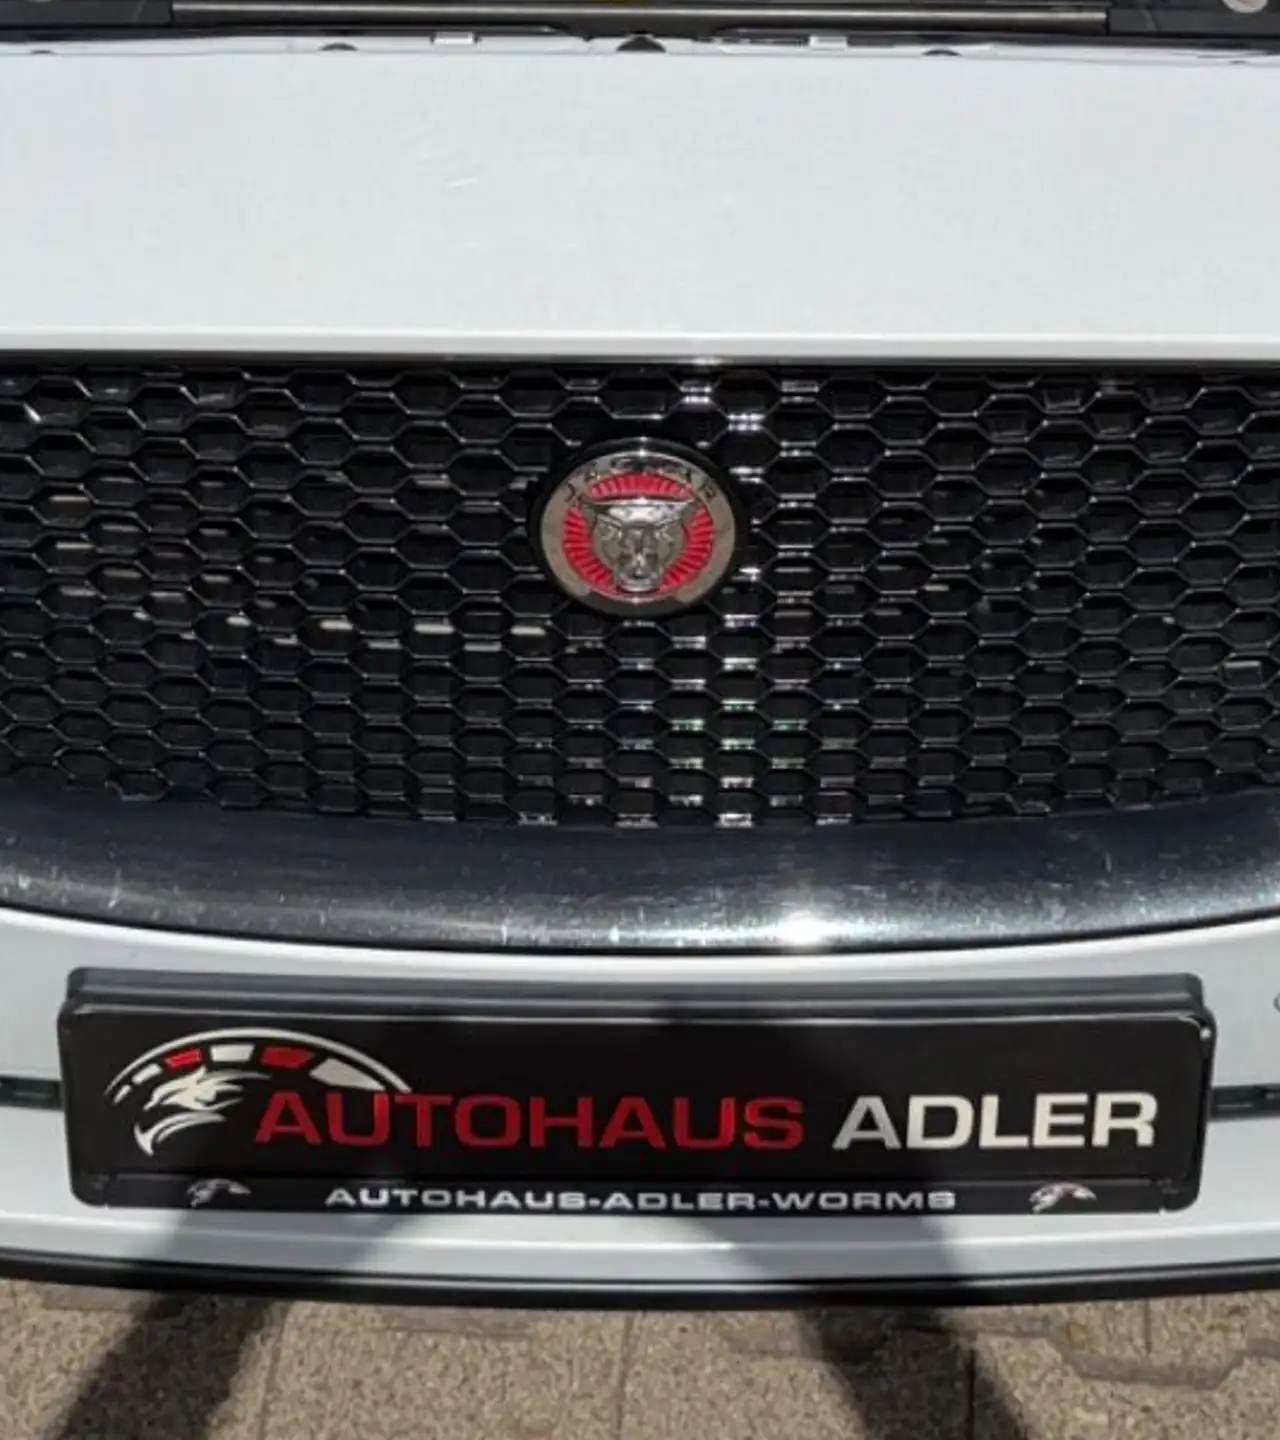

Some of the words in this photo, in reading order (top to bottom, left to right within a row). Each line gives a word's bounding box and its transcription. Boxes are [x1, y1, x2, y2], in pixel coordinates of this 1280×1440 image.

[255, 1091, 803, 1150] AUTOHAUS
[832, 1092, 1158, 1150] ADLER
[325, 1187, 957, 1211] AUTOHAUS-ADLER-WORMS
